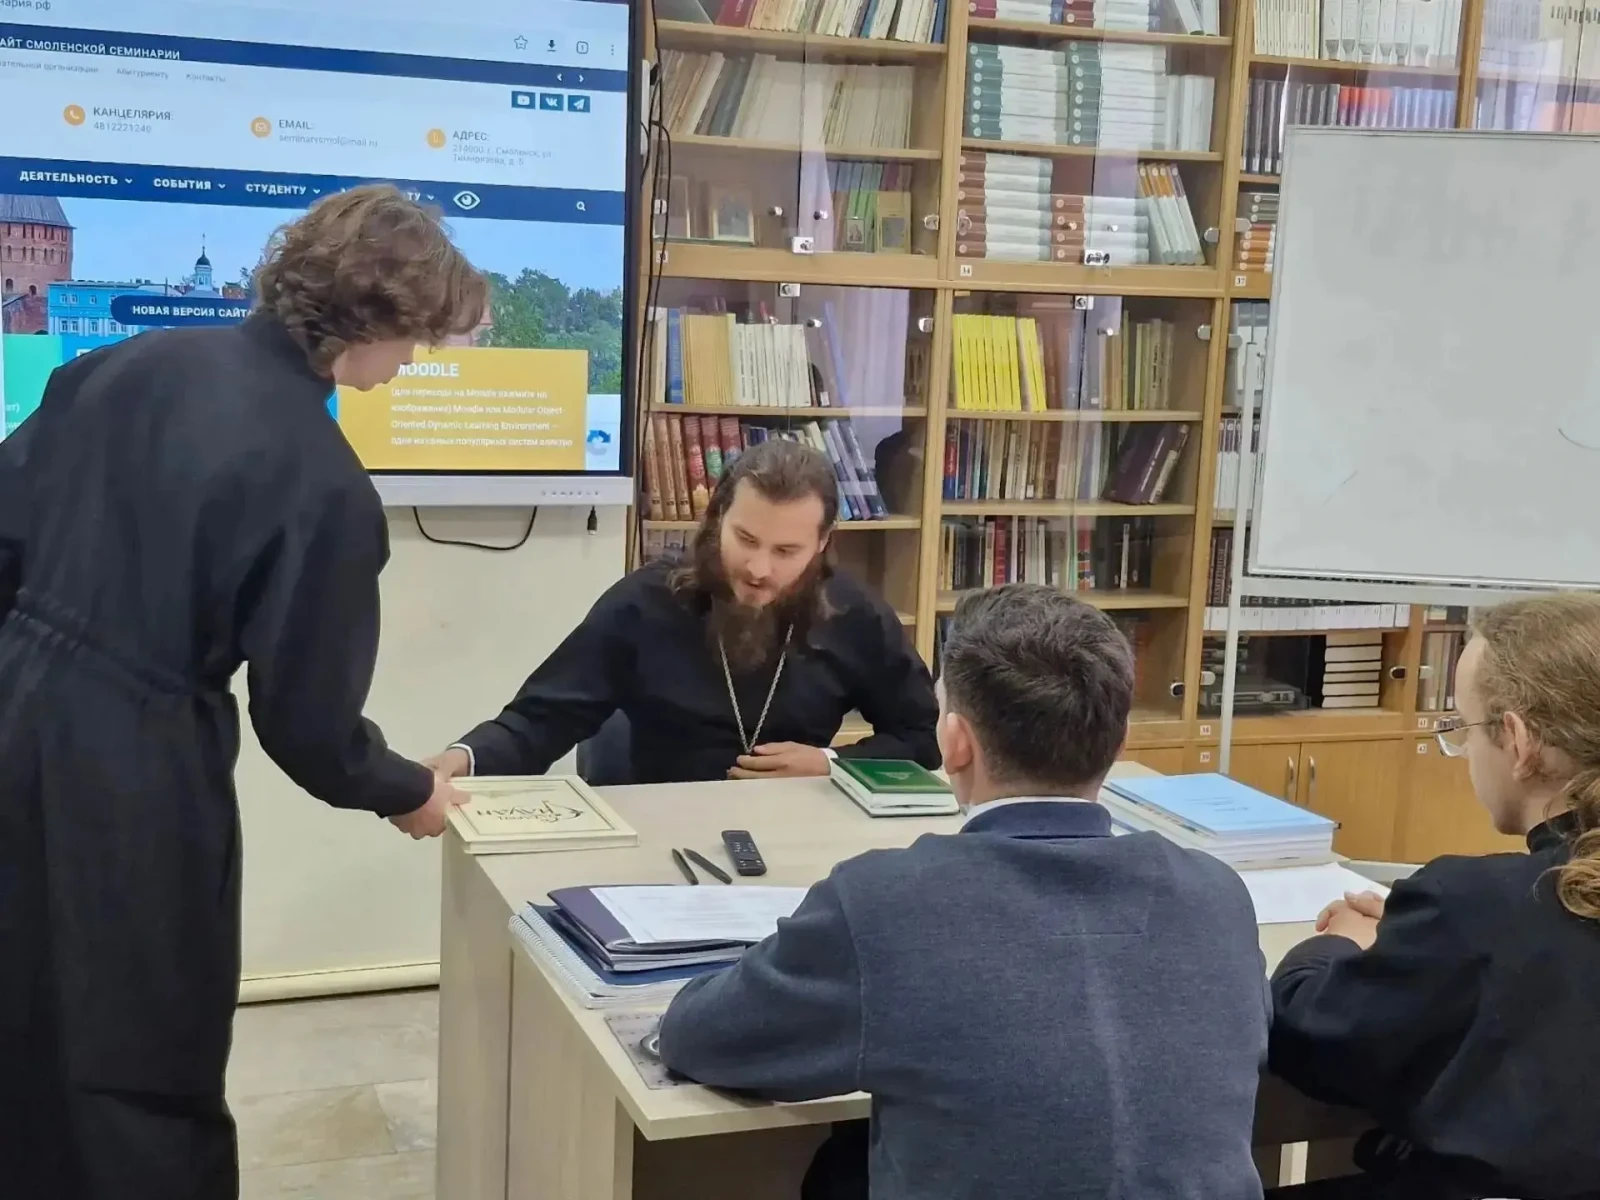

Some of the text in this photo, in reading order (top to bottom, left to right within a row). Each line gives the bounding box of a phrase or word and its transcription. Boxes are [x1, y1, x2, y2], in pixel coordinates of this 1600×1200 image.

[26, 39, 106, 55] СМОЛЕНСКОЙ
[109, 45, 181, 60] СЕМИНАРИИ
[93, 121, 152, 133] 4812221240
[19, 170, 118, 185] ДЕЯТЕЛЬНОСТЬ
[153, 177, 212, 190] СОБЫТИЯ
[245, 183, 307, 195] СТУДЕНТУ
[132, 305, 170, 316] НОВАЯ
[173, 307, 215, 317] ВЕРСИЯ
